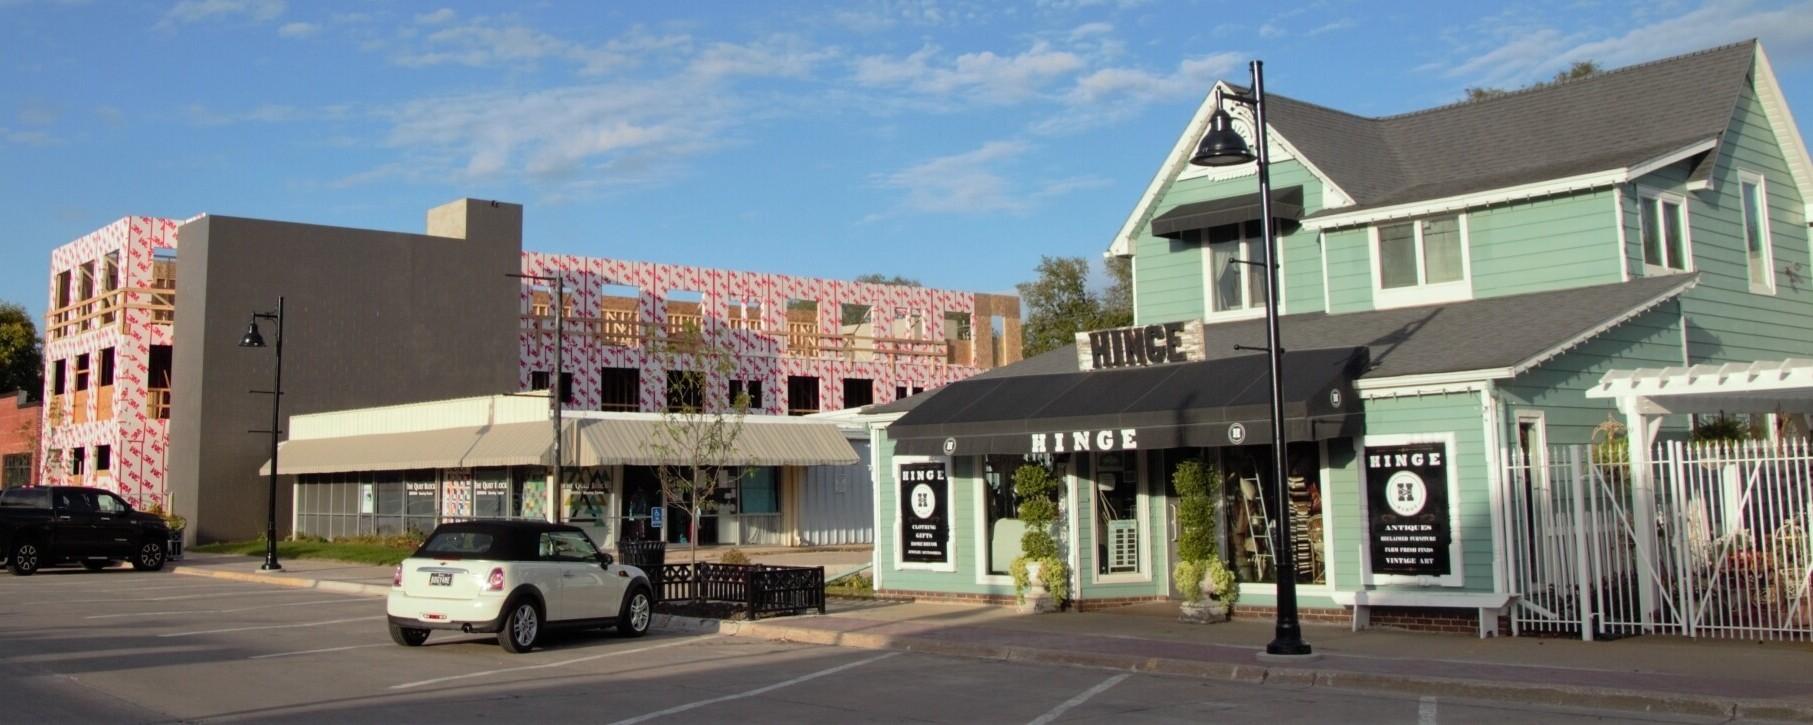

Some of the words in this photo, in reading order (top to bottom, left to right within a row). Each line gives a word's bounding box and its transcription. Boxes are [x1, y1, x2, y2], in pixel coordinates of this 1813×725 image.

[1088, 322, 1187, 369] HINGE
[1031, 429, 1138, 453] HINGE
[1369, 453, 1441, 468] HINGE
[902, 470, 944, 481] HINGE
[1397, 483, 1414, 501] H
[1385, 524, 1432, 532] ANTIQUES
